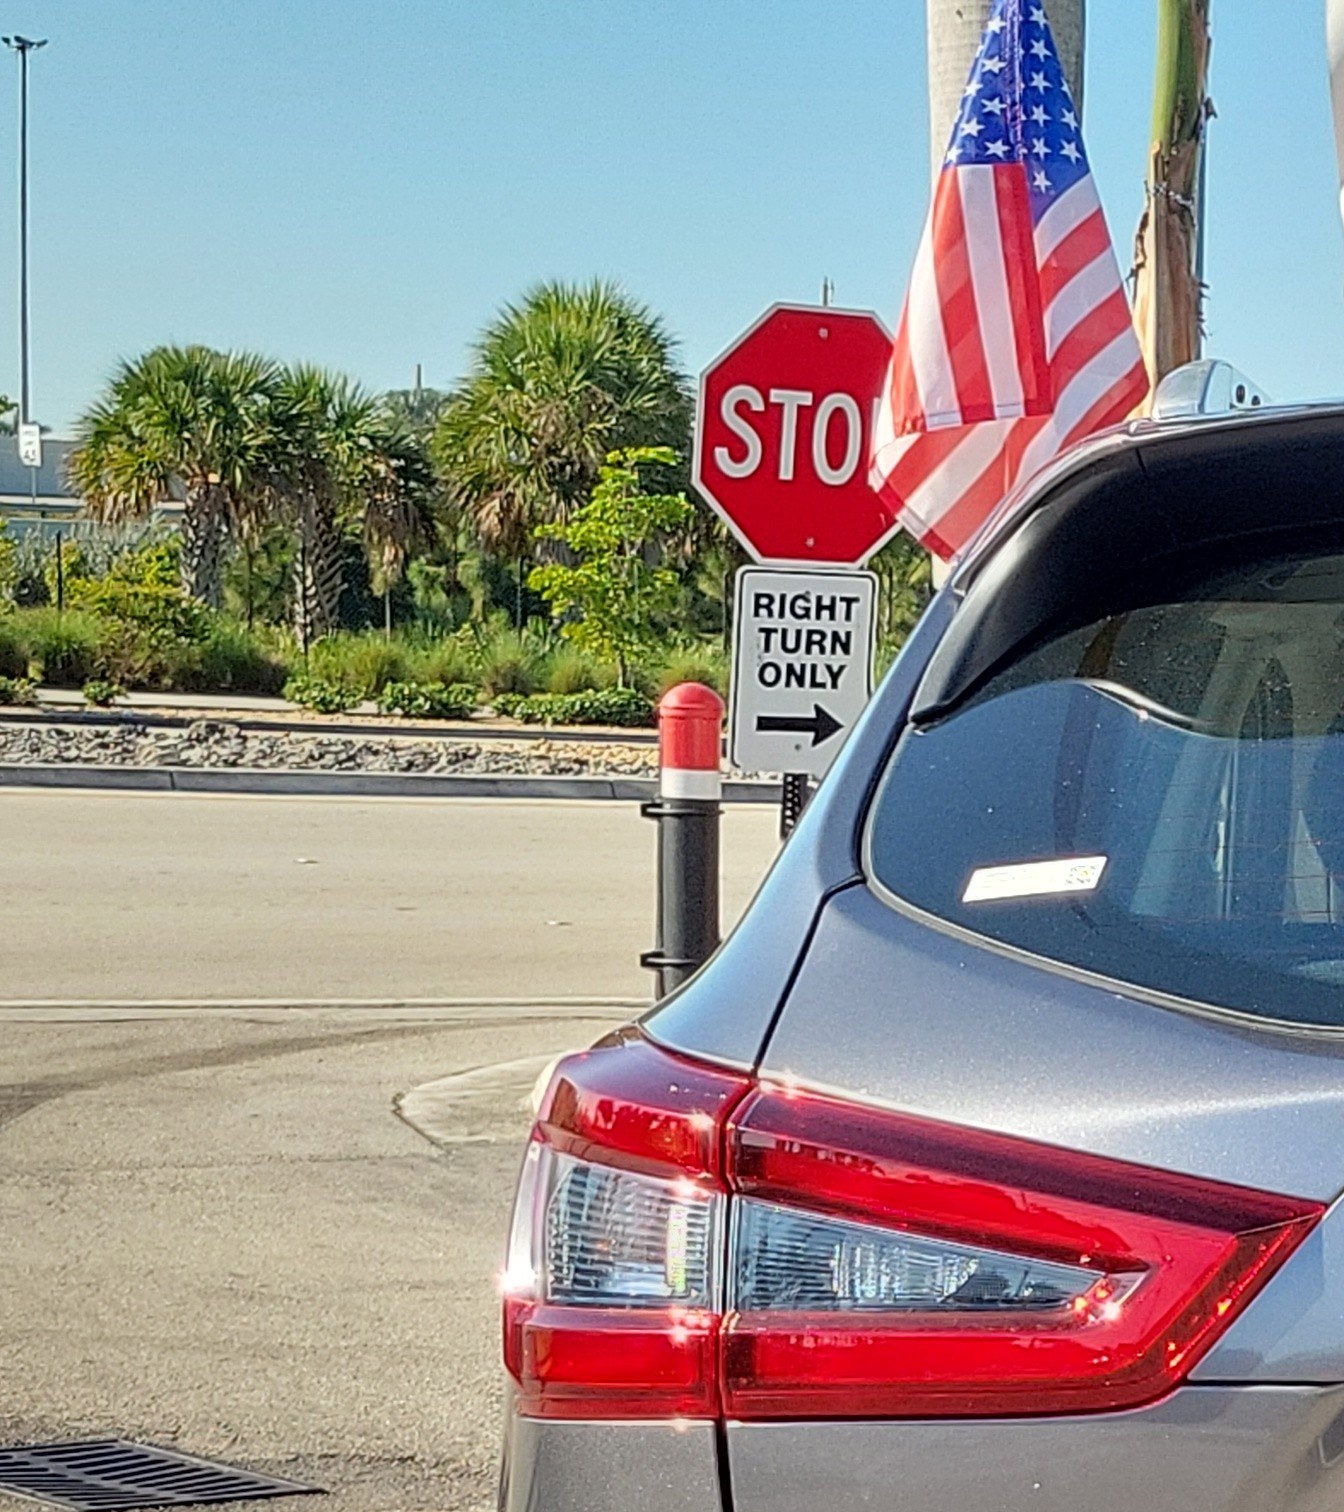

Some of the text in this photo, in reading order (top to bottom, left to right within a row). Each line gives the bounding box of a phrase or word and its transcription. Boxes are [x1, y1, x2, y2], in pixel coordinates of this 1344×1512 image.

[713, 384, 882, 486] STO
[753, 593, 860, 623] RIGHT
[758, 629, 852, 656] TURN
[757, 662, 847, 690] ONLY
